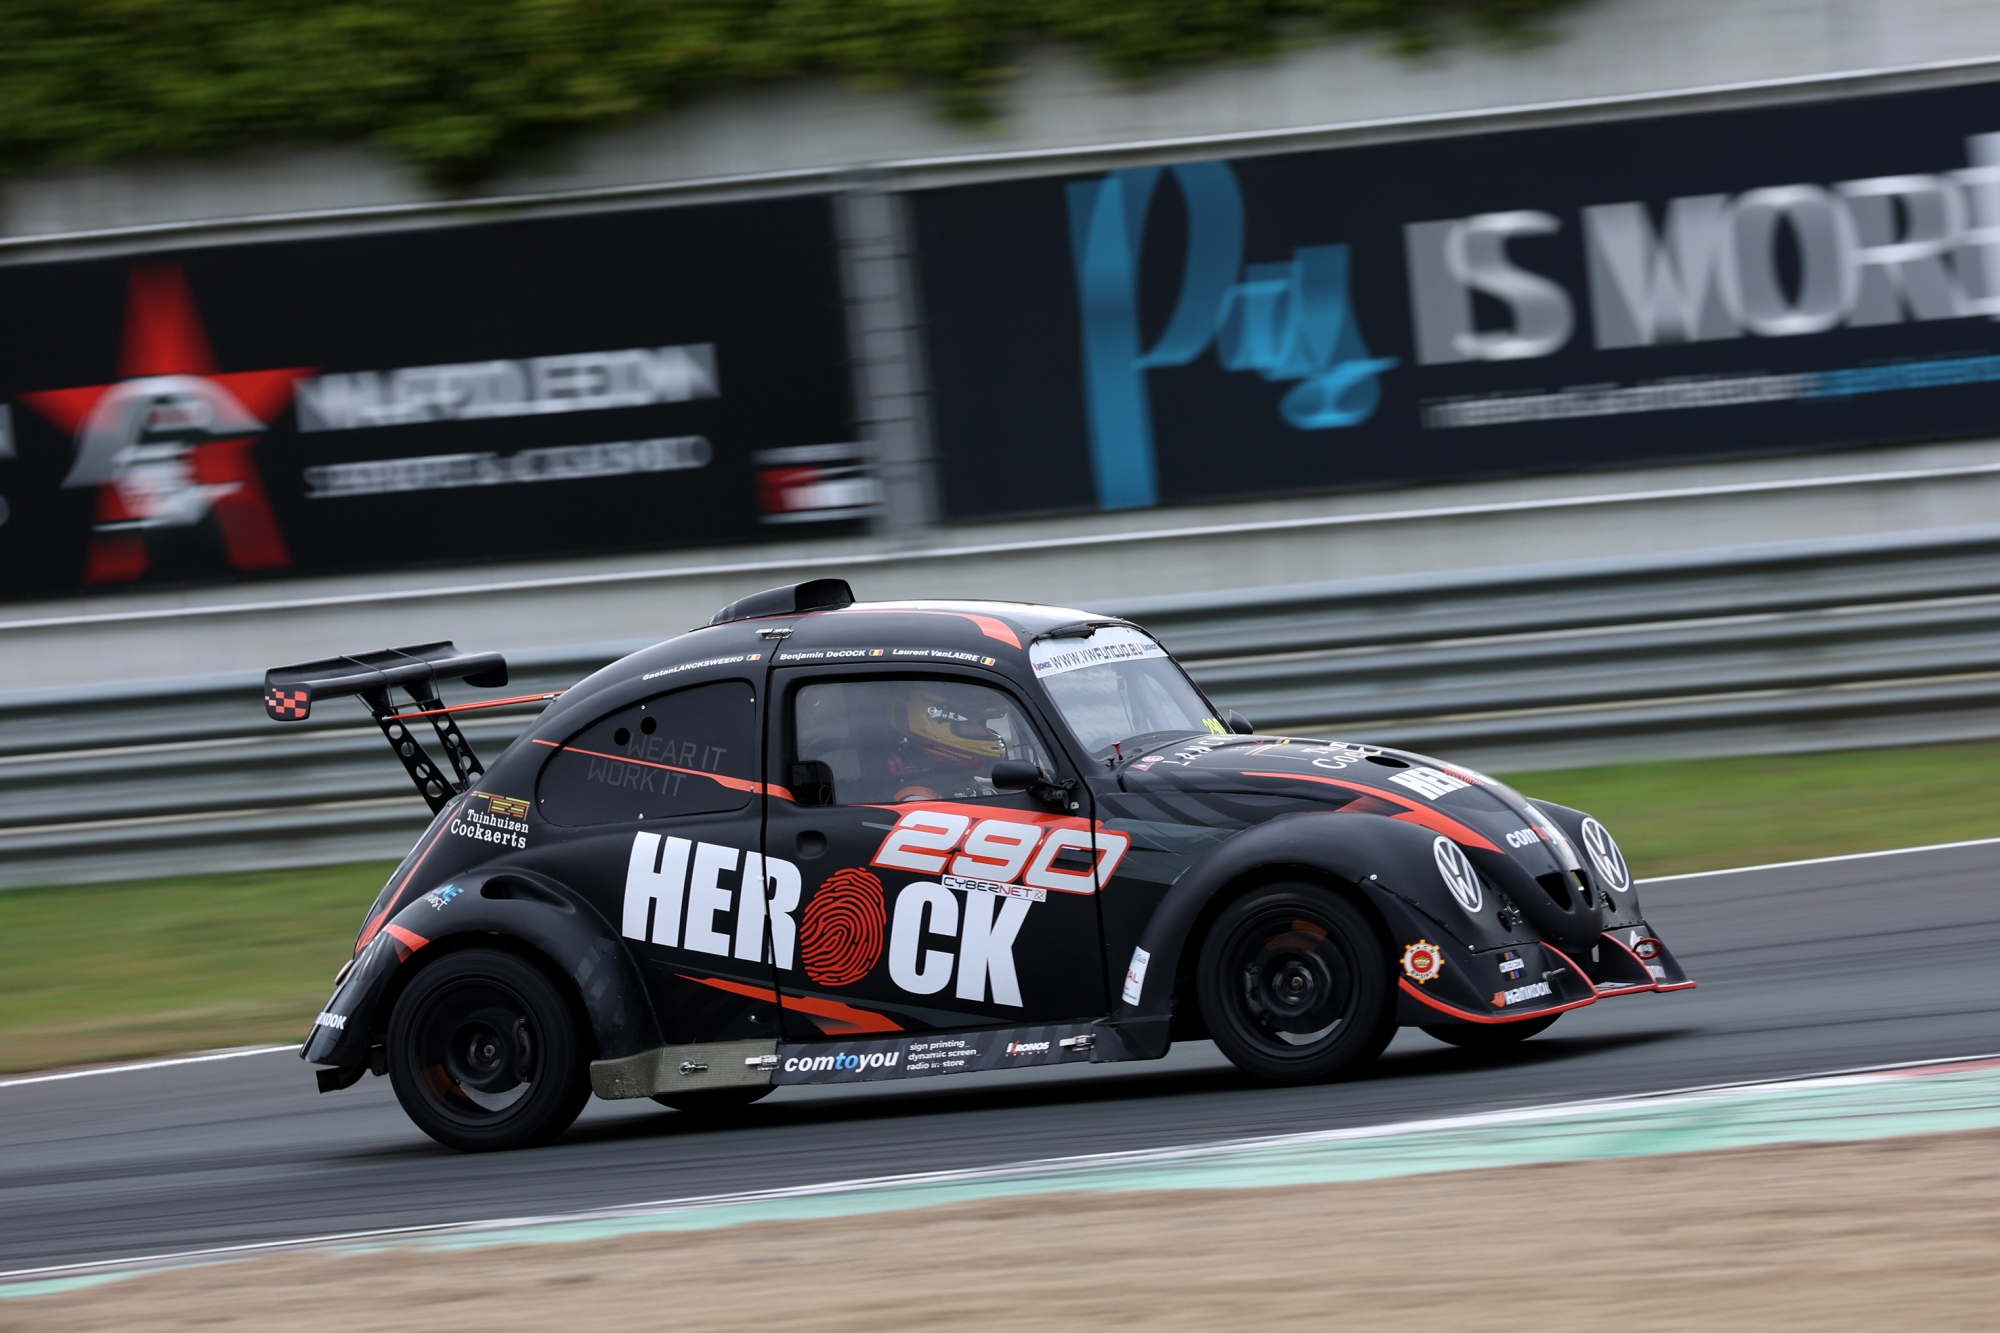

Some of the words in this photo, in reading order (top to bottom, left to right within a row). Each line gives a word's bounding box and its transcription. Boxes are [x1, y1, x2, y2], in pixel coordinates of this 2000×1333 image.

[779, 651, 824, 660] Benjamin
[826, 649, 867, 658] DeCOCK
[891, 648, 930, 657] Laurent
[931, 650, 980, 662] VanLAERE
[626, 732, 697, 767] WEAR
[701, 745, 727, 772] IT
[587, 757, 659, 794] WORK
[661, 771, 687, 797] IT
[467, 808, 529, 834] Tuinhuizen
[450, 818, 527, 849] Cockaerts
[871, 807, 1131, 896] 290
[908, 1052, 947, 1061] dynamic
[910, 1041, 928, 1051] sign
[784, 1050, 900, 1073] comtoyou
[906, 1061, 929, 1071] radio
